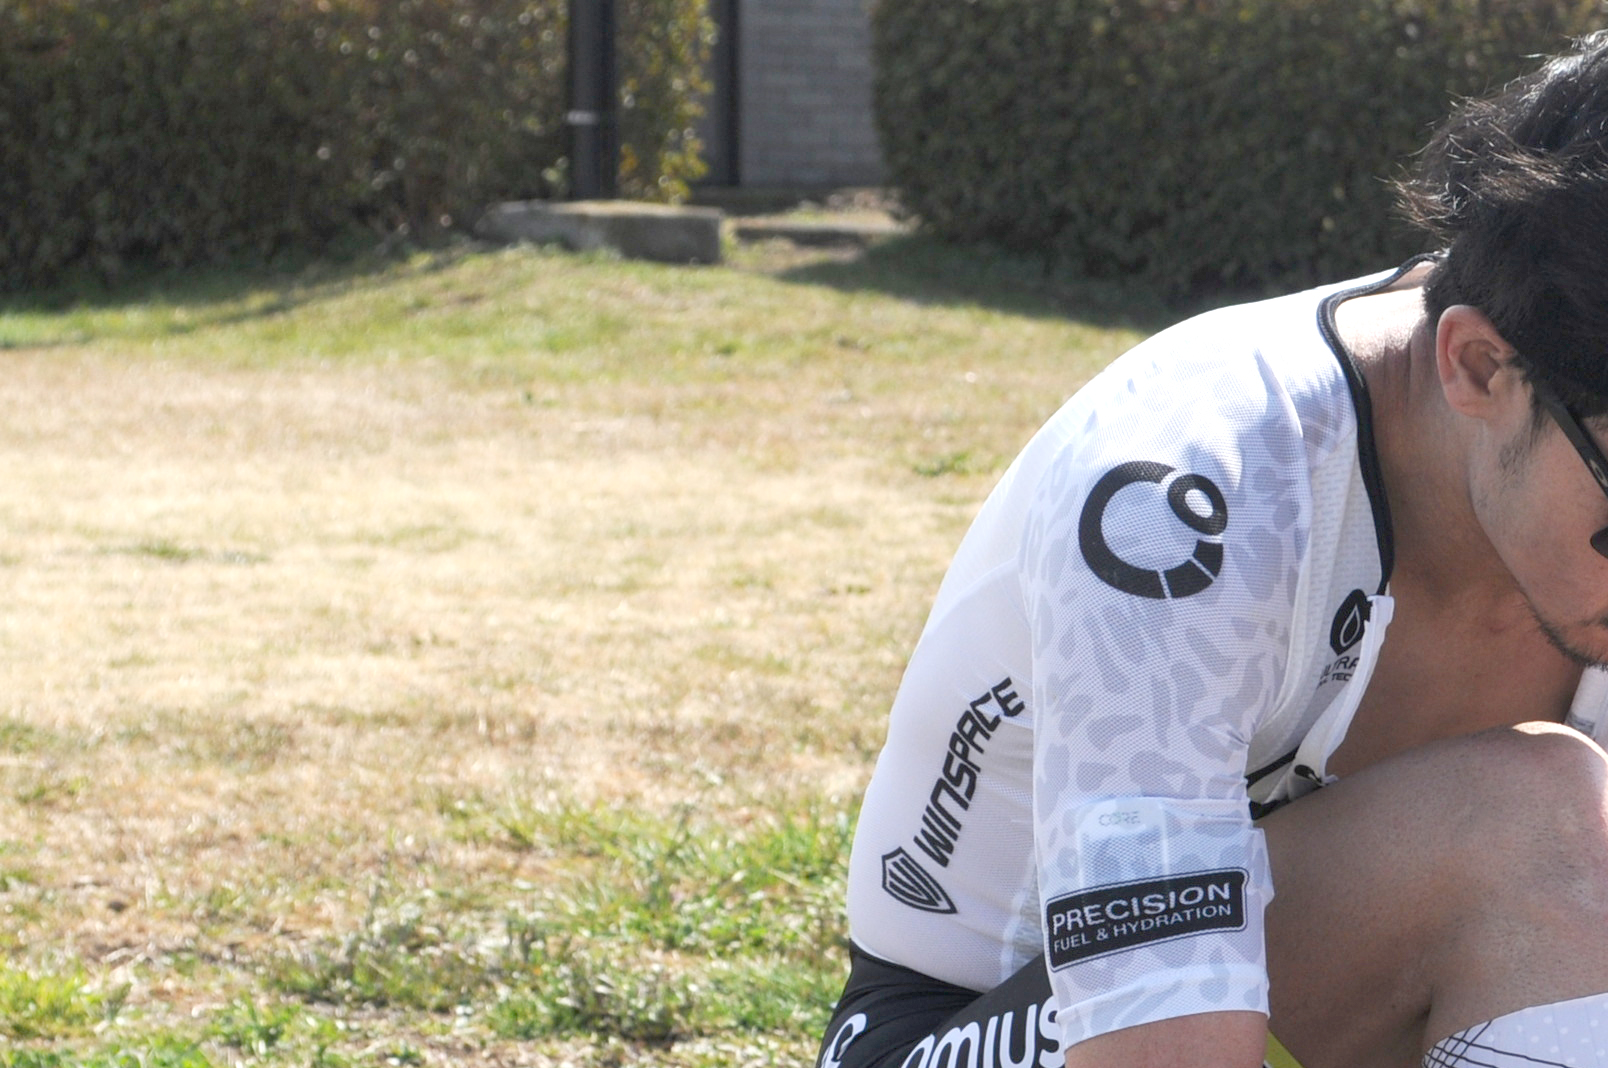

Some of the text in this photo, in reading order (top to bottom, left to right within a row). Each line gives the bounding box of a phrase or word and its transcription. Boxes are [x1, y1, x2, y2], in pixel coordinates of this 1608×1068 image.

[913, 677, 1025, 868] WINSPACE
[1052, 882, 1230, 936] PRECISION
[1054, 904, 1231, 953] FUEL & HYDRATION
